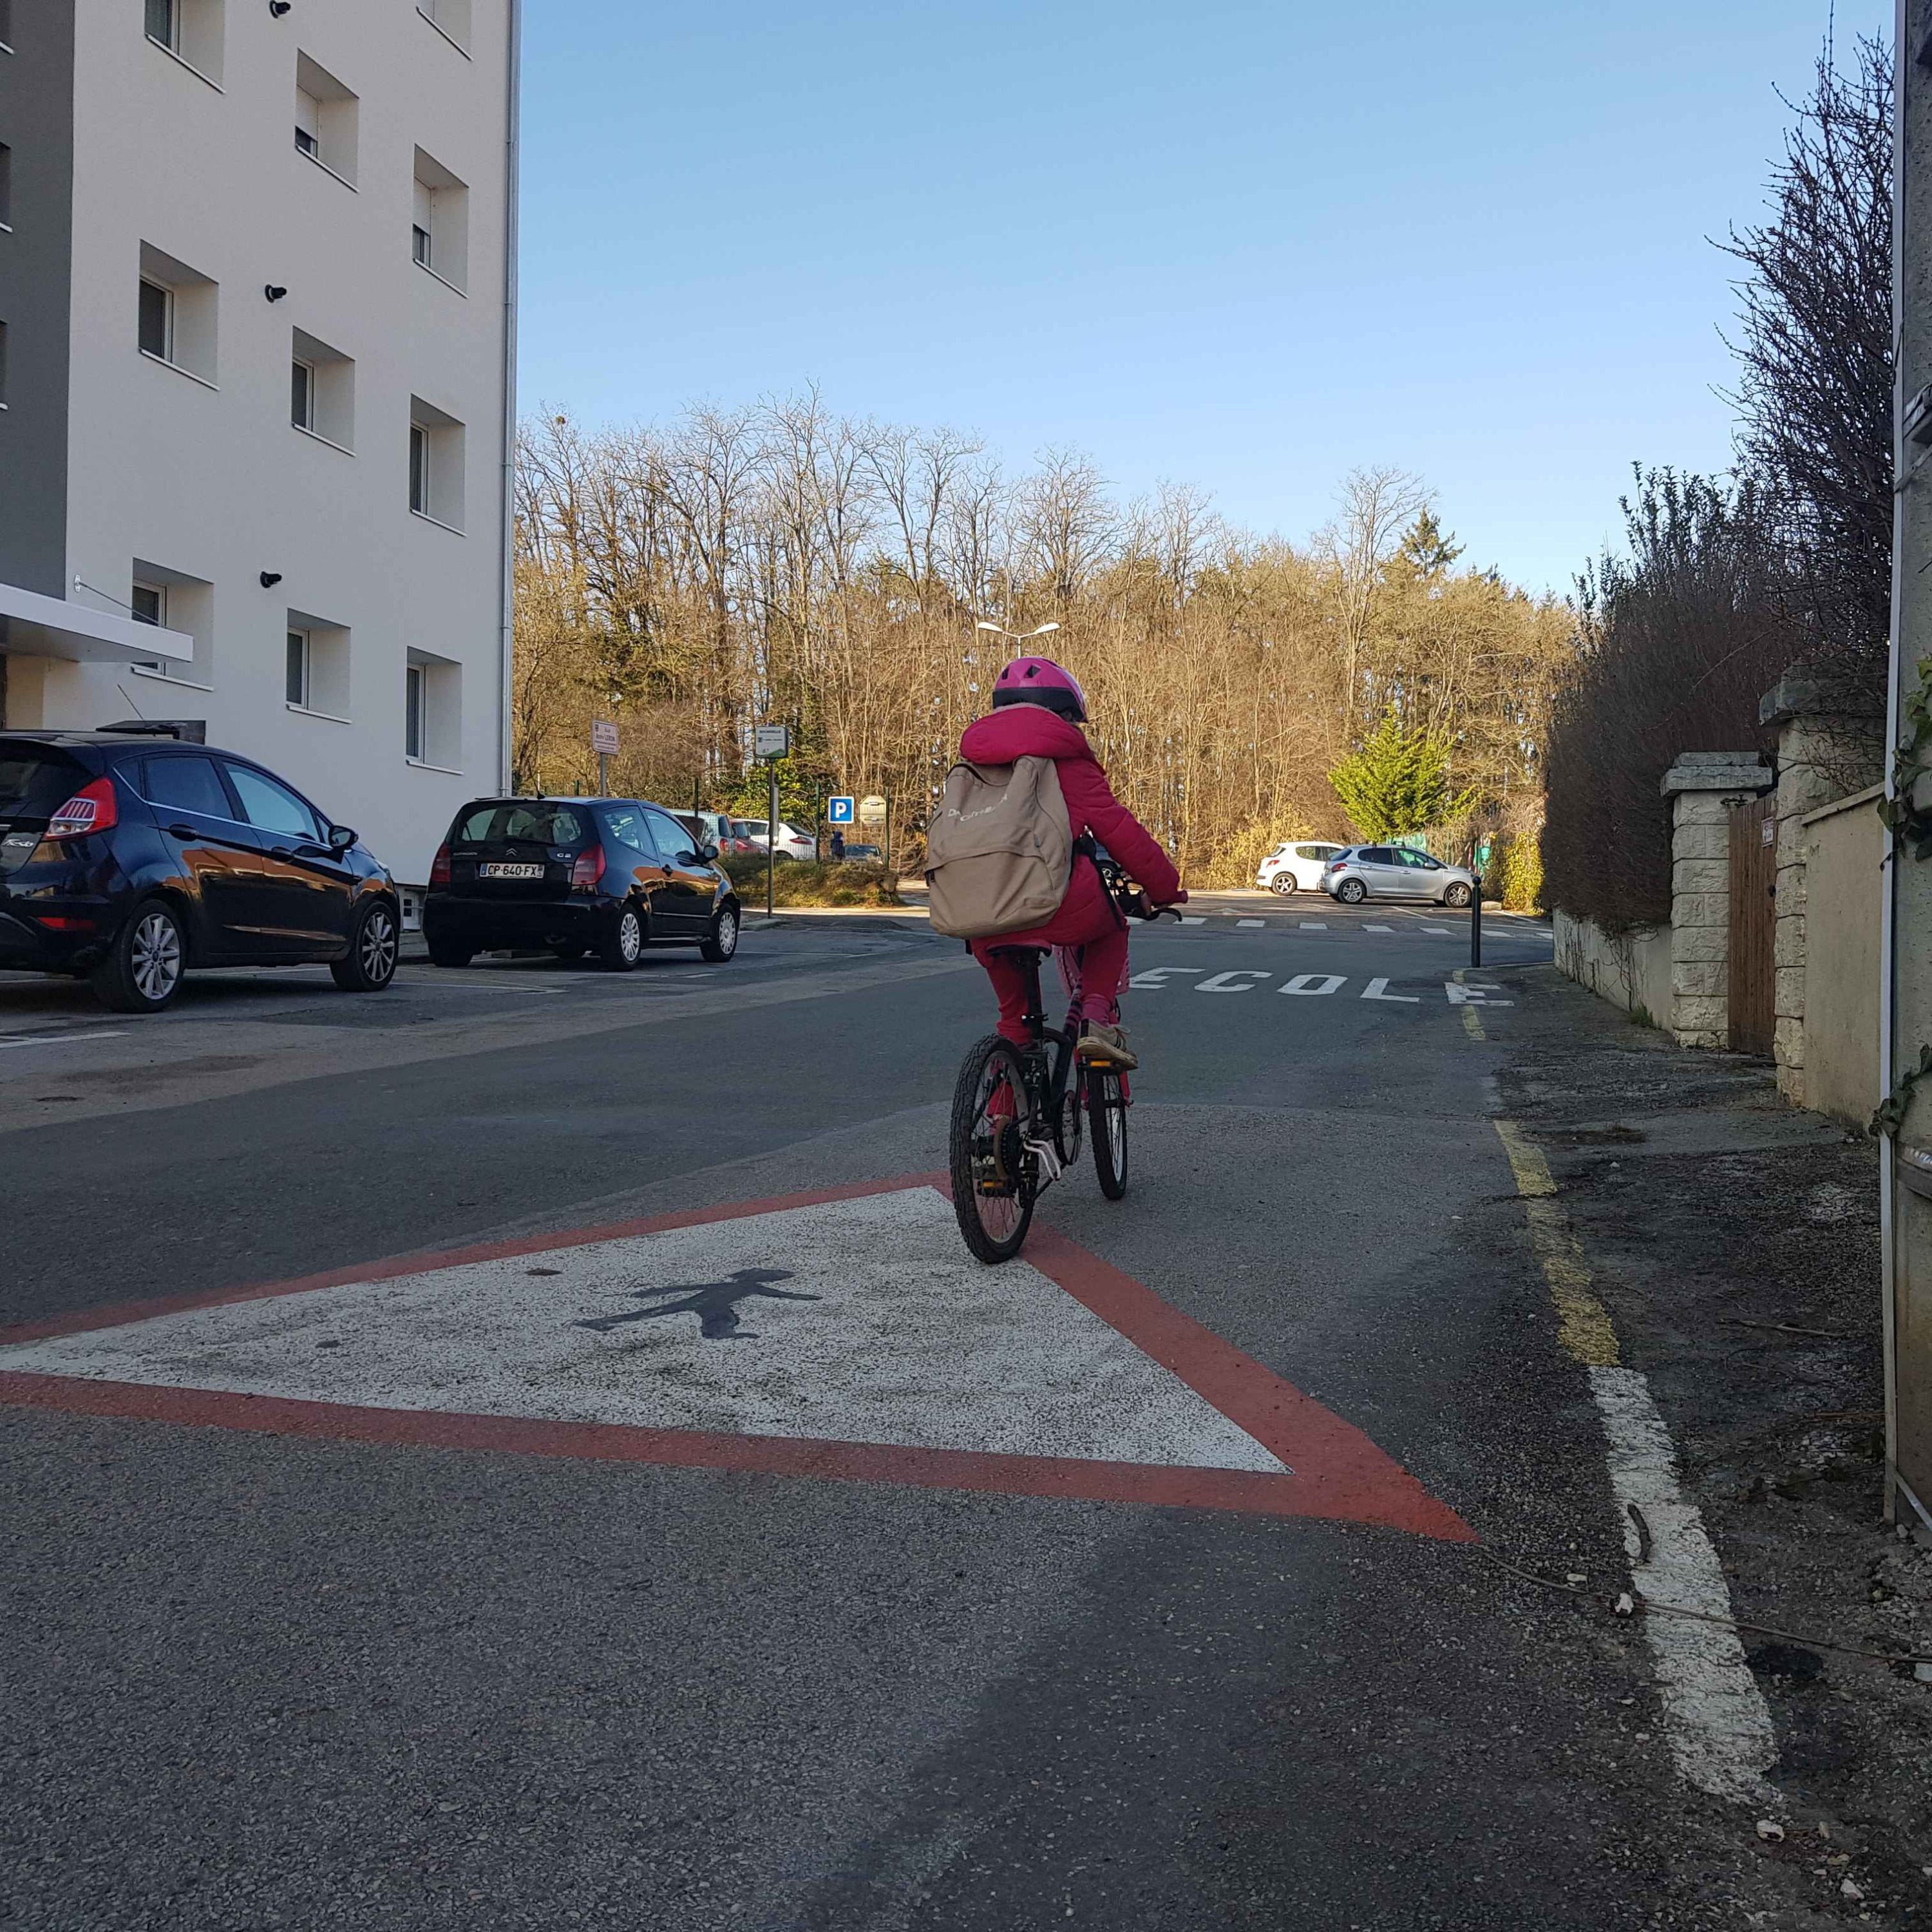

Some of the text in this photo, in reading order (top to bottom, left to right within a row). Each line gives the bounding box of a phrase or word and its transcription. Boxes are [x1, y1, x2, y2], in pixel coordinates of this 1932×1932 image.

[835, 802, 847, 819] P
[488, 865, 537, 876] CP-640-FX
[1130, 967, 1515, 1006] ECOLE
